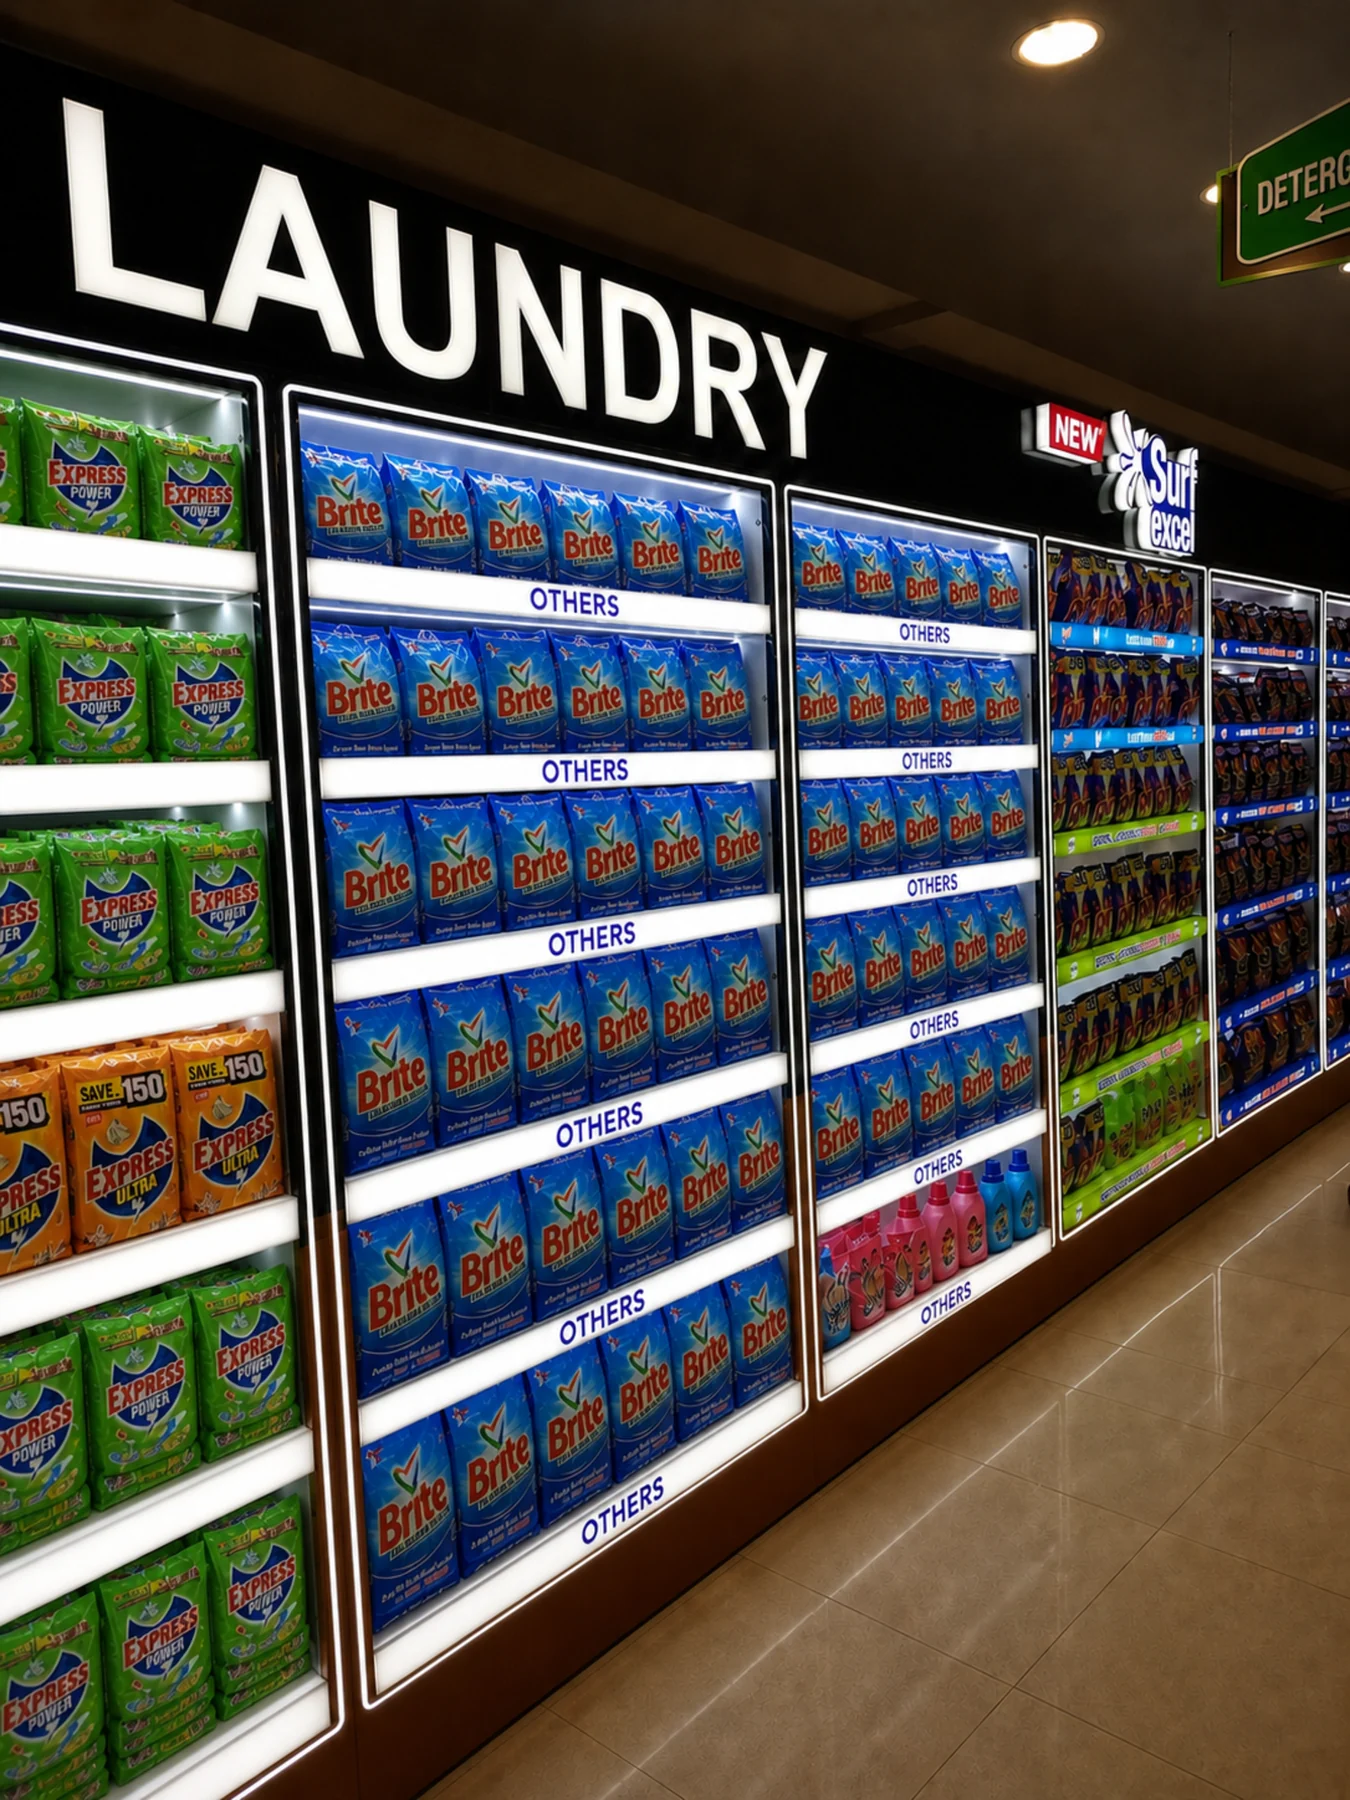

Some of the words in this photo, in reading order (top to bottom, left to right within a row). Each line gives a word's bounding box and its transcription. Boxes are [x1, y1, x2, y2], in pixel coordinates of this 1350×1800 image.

[62, 97, 827, 459] LAUNDRY
[1055, 413, 1102, 454] NEW
[49, 459, 126, 487] EXPRESS
[1149, 436, 1198, 510] Surf
[70, 485, 112, 500] POWER
[164, 481, 234, 505] EXPRESS
[183, 504, 220, 518] POWER
[318, 496, 382, 527] Brite
[410, 508, 466, 539] Brite
[490, 520, 542, 550] Brite
[565, 530, 612, 559] Brite
[1151, 508, 1195, 553] excel
[634, 540, 678, 568] Brite
[698, 546, 740, 573] Brite
[803, 562, 842, 586] Brite
[856, 570, 892, 592] Brite
[906, 578, 938, 600] Brite
[531, 588, 619, 617] OTHERS
[950, 581, 978, 604] Brite
[990, 586, 1018, 606] Brite
[900, 624, 950, 643] OTHERS
[58, 677, 135, 705] EXPRESS
[172, 679, 244, 706] EXPRESS
[328, 680, 391, 716] Brite
[418, 680, 476, 716] Brite
[498, 683, 552, 716] Brite
[573, 684, 621, 717] Brite
[640, 687, 686, 718] Brite
[702, 688, 744, 718] Brite
[800, 693, 838, 720] Brite
[850, 694, 884, 720] Brite
[896, 695, 929, 720] Brite
[80, 701, 122, 716] POWER
[193, 702, 231, 716] POWER
[942, 698, 974, 721] Brite
[986, 696, 1020, 720] Brite
[542, 759, 628, 783] OTHERS
[902, 752, 952, 769] OTHERS
[860, 820, 894, 848] Brite
[906, 816, 938, 842] Brite
[950, 813, 981, 840] Brite
[992, 809, 1023, 835] Brite
[654, 835, 700, 872] Brite
[716, 830, 760, 865] Brite
[808, 824, 846, 854] Brite
[432, 855, 491, 898] Brite
[514, 848, 567, 888] Brite
[586, 842, 636, 880] Brite
[190, 882, 260, 916] EXPRESS
[346, 862, 409, 908] Brite
[907, 874, 957, 896] OTHERS
[81, 888, 157, 925] EXPRESS
[103, 914, 143, 933] POWER
[549, 922, 635, 956] OTHERS
[912, 943, 944, 976] Brite
[954, 934, 986, 966] Brite
[996, 928, 1026, 958] Brite
[812, 964, 853, 1002] Brite
[866, 952, 900, 988] Brite
[664, 992, 710, 1035] Brite
[724, 980, 766, 1020] Brite
[598, 1007, 648, 1051] Brite
[910, 1011, 959, 1038] OTHERS
[528, 1021, 582, 1071] Brite
[224, 1053, 264, 1080] 150
[448, 1039, 508, 1090] Brite
[1002, 1056, 1031, 1089] Brite
[121, 1073, 164, 1103] 150
[358, 1058, 425, 1113] Brite
[922, 1084, 953, 1120] Brite
[962, 1069, 992, 1102] Brite
[0, 1097, 46, 1129] 150
[557, 1102, 642, 1147] OTHERS
[872, 1098, 908, 1138] Brite
[193, 1112, 275, 1172] EXPRESS
[818, 1116, 858, 1160] Brite
[85, 1137, 174, 1201] EXPRESS
[222, 1145, 259, 1176] ULTRA
[740, 1142, 779, 1186] Brite
[914, 1150, 963, 1184] OTHERS
[116, 1174, 157, 1206] ULTRA
[684, 1163, 727, 1210] Brite
[618, 1184, 668, 1236] Brite
[544, 1210, 598, 1265] Brite
[462, 1236, 524, 1296] Brite
[370, 1264, 439, 1331] Brite
[921, 1282, 971, 1324] OTHERS
[560, 1289, 645, 1345] OTHERS
[744, 1308, 786, 1356] Brite
[216, 1323, 286, 1376] EXPRESS
[684, 1334, 727, 1388] Brite
[238, 1354, 273, 1381] POWER
[107, 1358, 185, 1415] EXPRESS
[621, 1363, 669, 1422] Brite
[131, 1391, 171, 1419] POWER
[548, 1396, 604, 1460] Brite
[12, 1434, 56, 1467] POWER
[468, 1434, 530, 1503] Brite
[379, 1478, 447, 1555] Brite
[582, 1477, 663, 1544] OTHERS
[229, 1556, 296, 1614] EXPRESS
[248, 1584, 283, 1613] POWER
[123, 1606, 198, 1671] EXPRESS
[146, 1639, 185, 1667] POWER
[2, 1661, 89, 1733] EXPRESS
[28, 1695, 72, 1732] POWER
